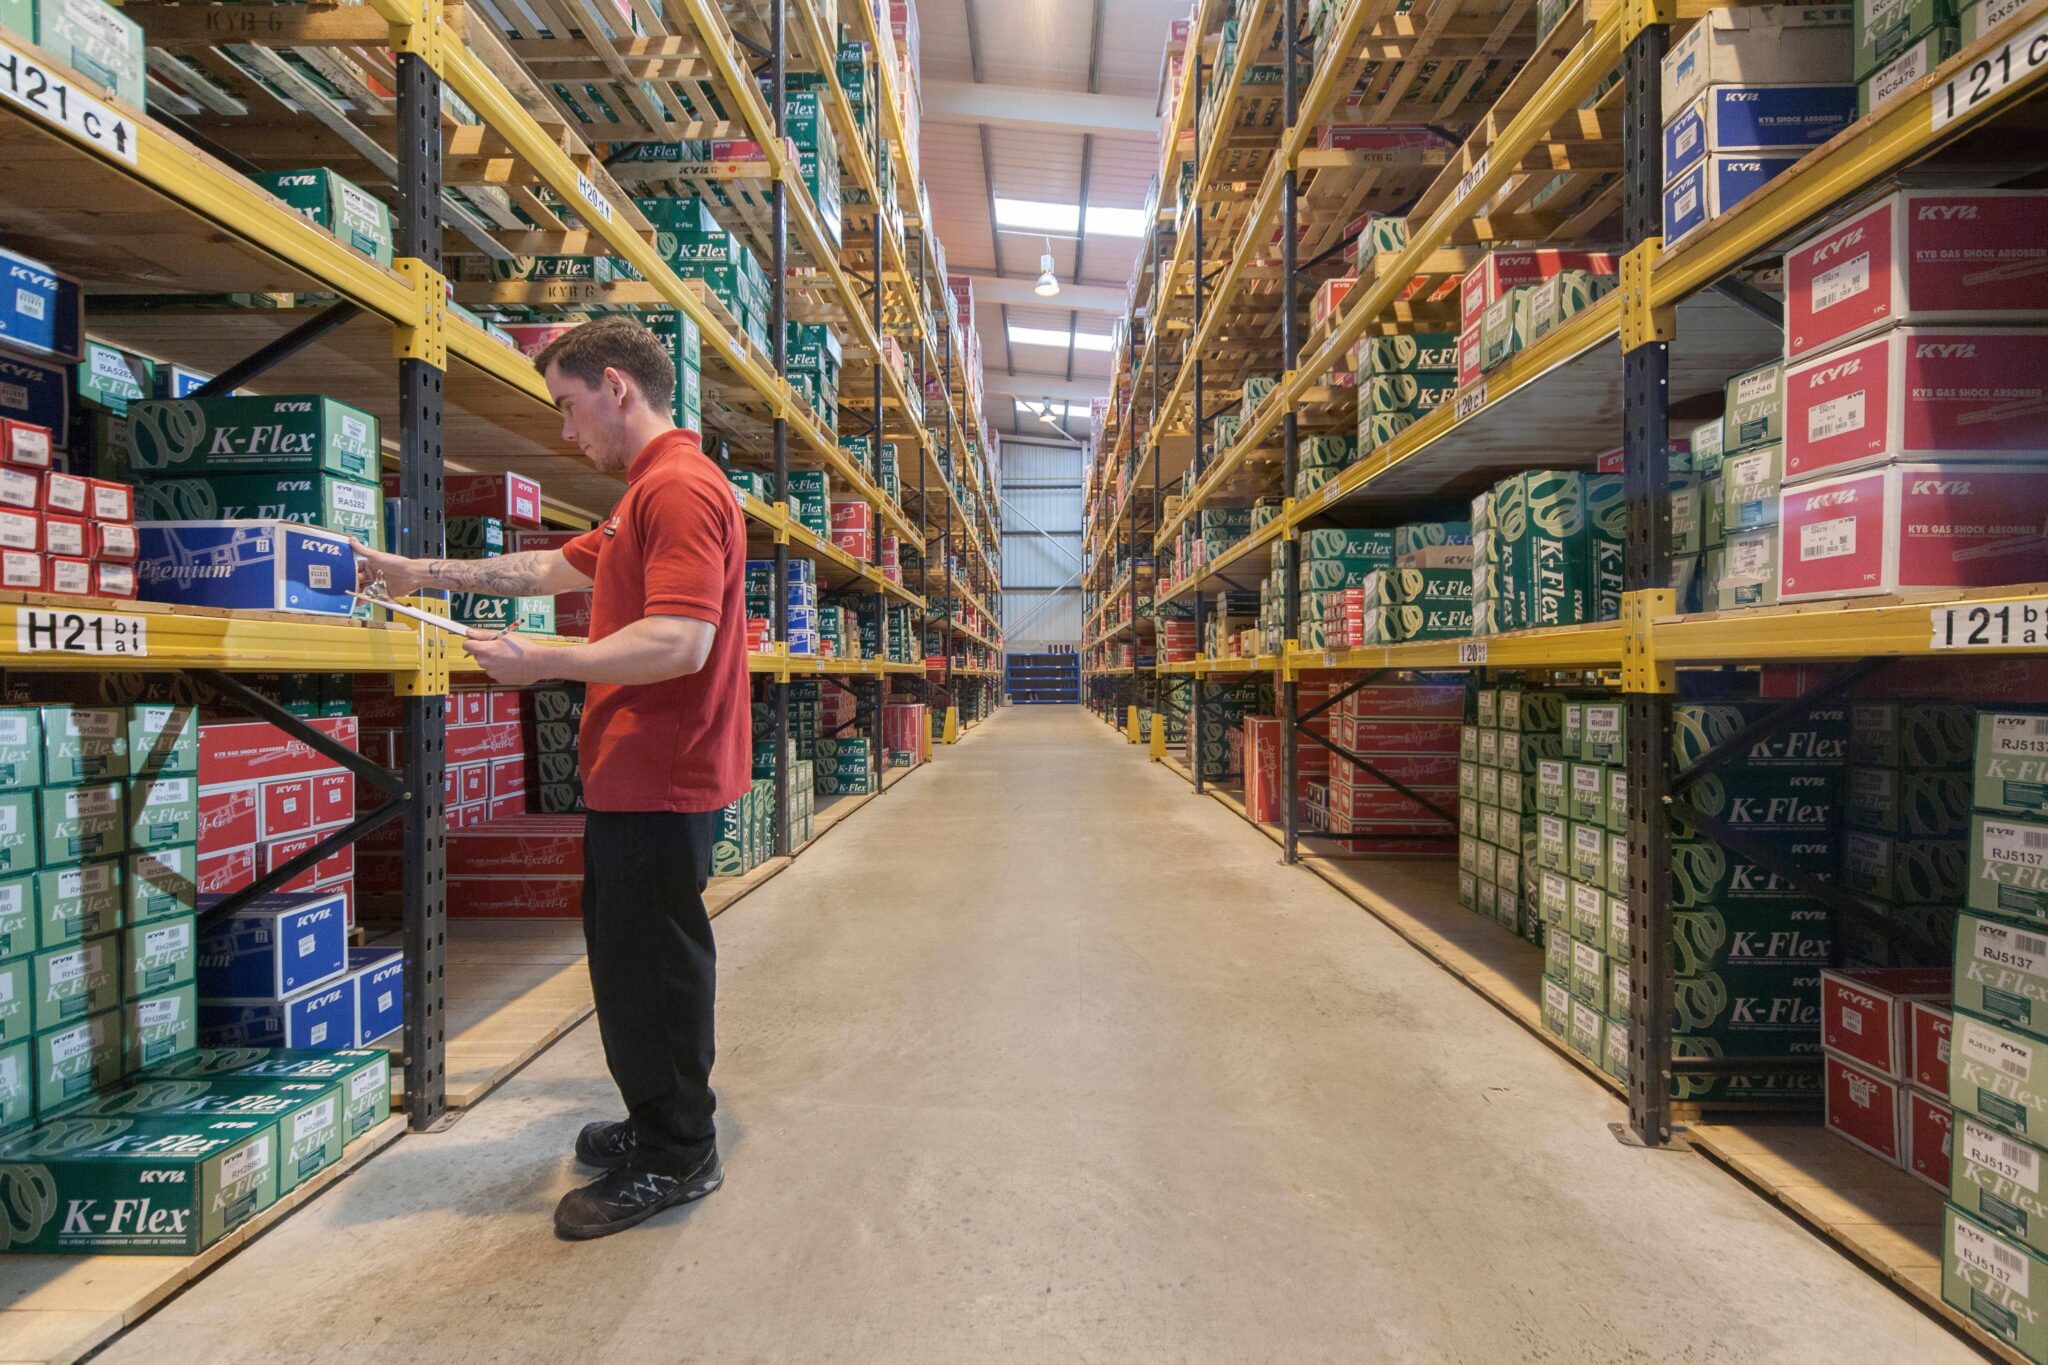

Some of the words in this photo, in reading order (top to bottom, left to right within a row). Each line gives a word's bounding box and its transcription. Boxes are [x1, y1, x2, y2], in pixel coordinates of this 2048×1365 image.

[1876, 65, 1896, 83] KYB
[1969, 44, 2010, 106] 21
[1878, 67, 1915, 100] RC5476
[1725, 93, 1758, 101] KYB
[1674, 110, 1695, 133] KYB
[638, 144, 679, 158] K-Flex
[1727, 163, 1761, 172] KYB
[278, 175, 317, 187] KYB
[1673, 177, 1695, 198] KYB
[1918, 205, 1978, 220] KYB
[342, 210, 387, 246] K-Flex
[679, 244, 728, 257] K-Flex
[1812, 227, 1864, 265] KYB
[1916, 250, 1939, 259] KYB
[1940, 250, 1961, 258] GAS
[1963, 250, 1995, 258] SHOCK
[535, 259, 591, 276] K-Flex
[1499, 256, 1531, 266] KYB
[10, 266, 59, 290] KYB
[646, 315, 675, 323] KYB
[1915, 344, 1976, 359] KYB
[1741, 376, 1758, 387] KYB
[1809, 359, 1860, 388] KYB
[1739, 383, 1773, 400] RH1246
[1913, 389, 1933, 397] KYB
[1936, 389, 1957, 397] GAS
[1959, 389, 1990, 397] SHOCK
[1993, 388, 2042, 397] ABSORBER
[274, 402, 312, 413] KYB
[1731, 400, 1781, 426] K-Flex
[208, 424, 315, 455] K-Flex
[332, 433, 375, 460] K-Flex
[276, 481, 312, 492] KYB
[788, 481, 821, 490] K-Flex
[1912, 481, 1971, 495] KYB
[338, 497, 367, 510] RA5282
[1805, 488, 1856, 511] KYB
[333, 509, 378, 531] K-Flex
[1908, 525, 1928, 534] KYB
[1931, 525, 1951, 533] GAS
[1954, 525, 1985, 533] SHOCK
[1989, 526, 2036, 534] ABSORBER
[302, 538, 342, 557] KYB
[1346, 542, 1392, 555] K-Flex
[138, 557, 233, 579] Premium
[1541, 538, 1565, 625] K-Flex
[521, 598, 550, 613] K-Flex
[1427, 611, 1473, 627] K-Fle
[1968, 606, 2009, 644] 21
[2024, 606, 2038, 623] b
[29, 611, 104, 652] H21
[114, 619, 127, 635] b
[2023, 629, 2037, 643] a
[115, 640, 127, 652] a
[1809, 711, 1843, 720] KYB
[136, 737, 191, 751] K-Flex
[1586, 730, 1622, 743] K-Flex
[838, 764, 866, 773] K-Flex
[276, 784, 302, 794] KYB
[322, 776, 345, 786] KYB
[839, 784, 867, 792] K-Flex
[1790, 777, 1825, 786] KYB
[138, 808, 191, 826] K-Flex
[1728, 798, 1830, 823] K-Flex
[54, 818, 116, 839] K-Flex
[1986, 826, 2015, 836] KYB
[1792, 844, 1827, 853] KYB
[1993, 848, 2043, 865] RJ5137
[51, 895, 112, 921] K-Flex
[1791, 911, 1827, 920] KYB
[297, 908, 331, 928] KYB
[1979, 924, 2007, 938] KYB
[1729, 931, 1831, 957] K-Flex
[135, 949, 188, 973] K-Flex
[1984, 946, 2033, 970] RJ5137
[373, 964, 403, 984] KYB
[46, 972, 109, 1003] K-Flex
[307, 990, 342, 1013] KYB
[1838, 988, 1875, 1010] KYB
[135, 1018, 190, 1048] K-Flex
[1968, 1037, 1996, 1055] RJ5137
[2001, 1041, 2027, 1058] KYB
[1961, 1060, 2047, 1112] K-Flex
[1966, 1124, 1994, 1142] KYB
[287, 1125, 337, 1165] K-Flex
[223, 1150, 243, 1165] KYB
[1971, 1147, 2020, 1179] RJ5137
[140, 1169, 186, 1183] KYB
[211, 1167, 270, 1214] K-Flex
[1962, 1160, 2048, 1219] K-Flex
[60, 1198, 190, 1234] K-Flex
[1958, 1223, 1985, 1243] KYB
[1964, 1247, 2011, 1283] RJ5137
[1955, 1260, 2040, 1324] K-Flex
